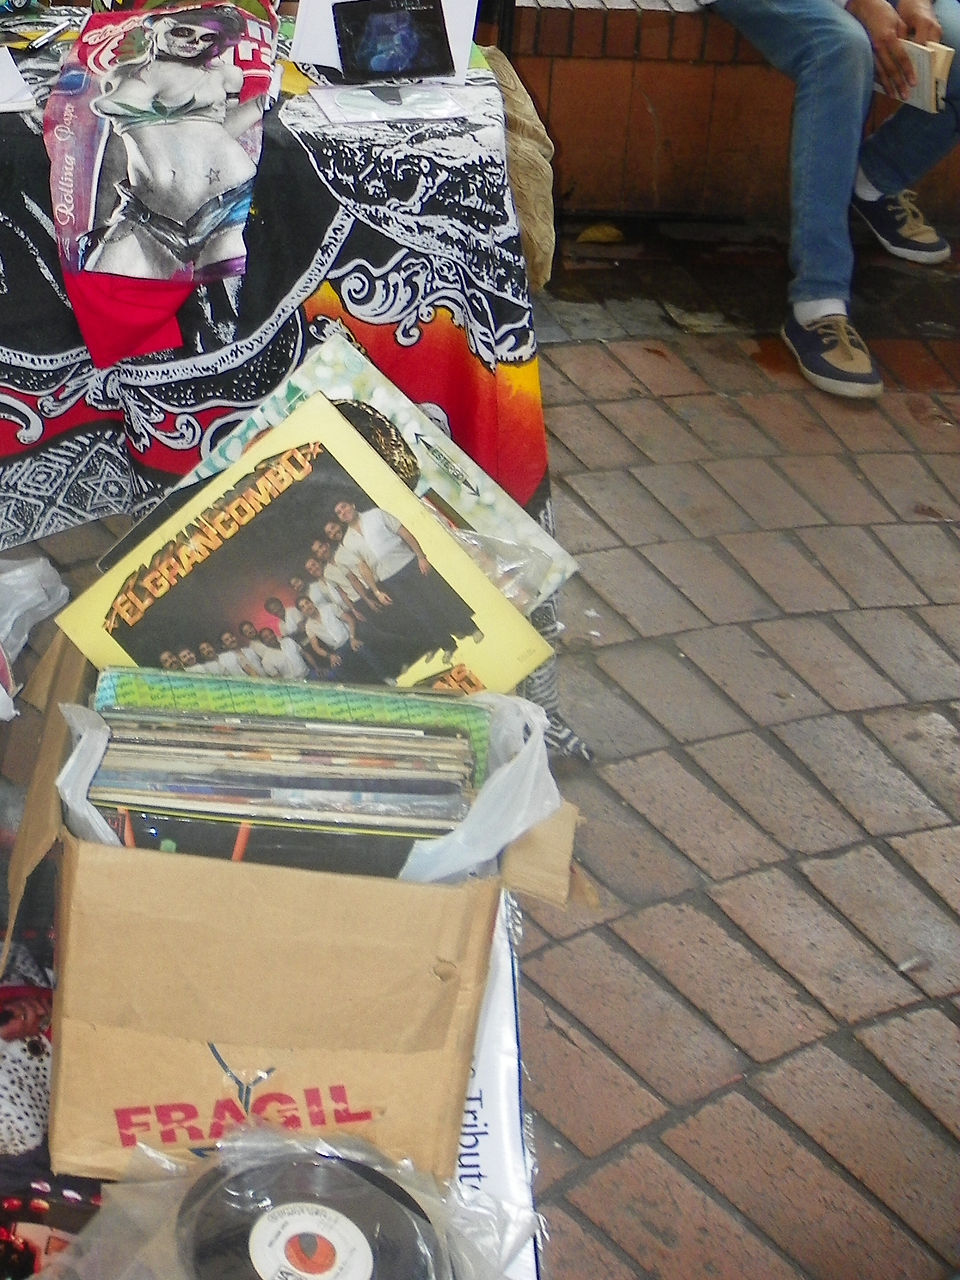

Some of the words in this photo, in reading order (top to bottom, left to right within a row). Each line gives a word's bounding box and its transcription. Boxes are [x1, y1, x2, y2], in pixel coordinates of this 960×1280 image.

[54, 154, 76, 226] Rolling
[430, 448, 466, 483] ESTEREO
[143, 517, 224, 600] GRAN
[214, 448, 313, 540] COMBO
[114, 1084, 372, 1148] FRAGIL
[458, 1089, 489, 1191] Tribut
